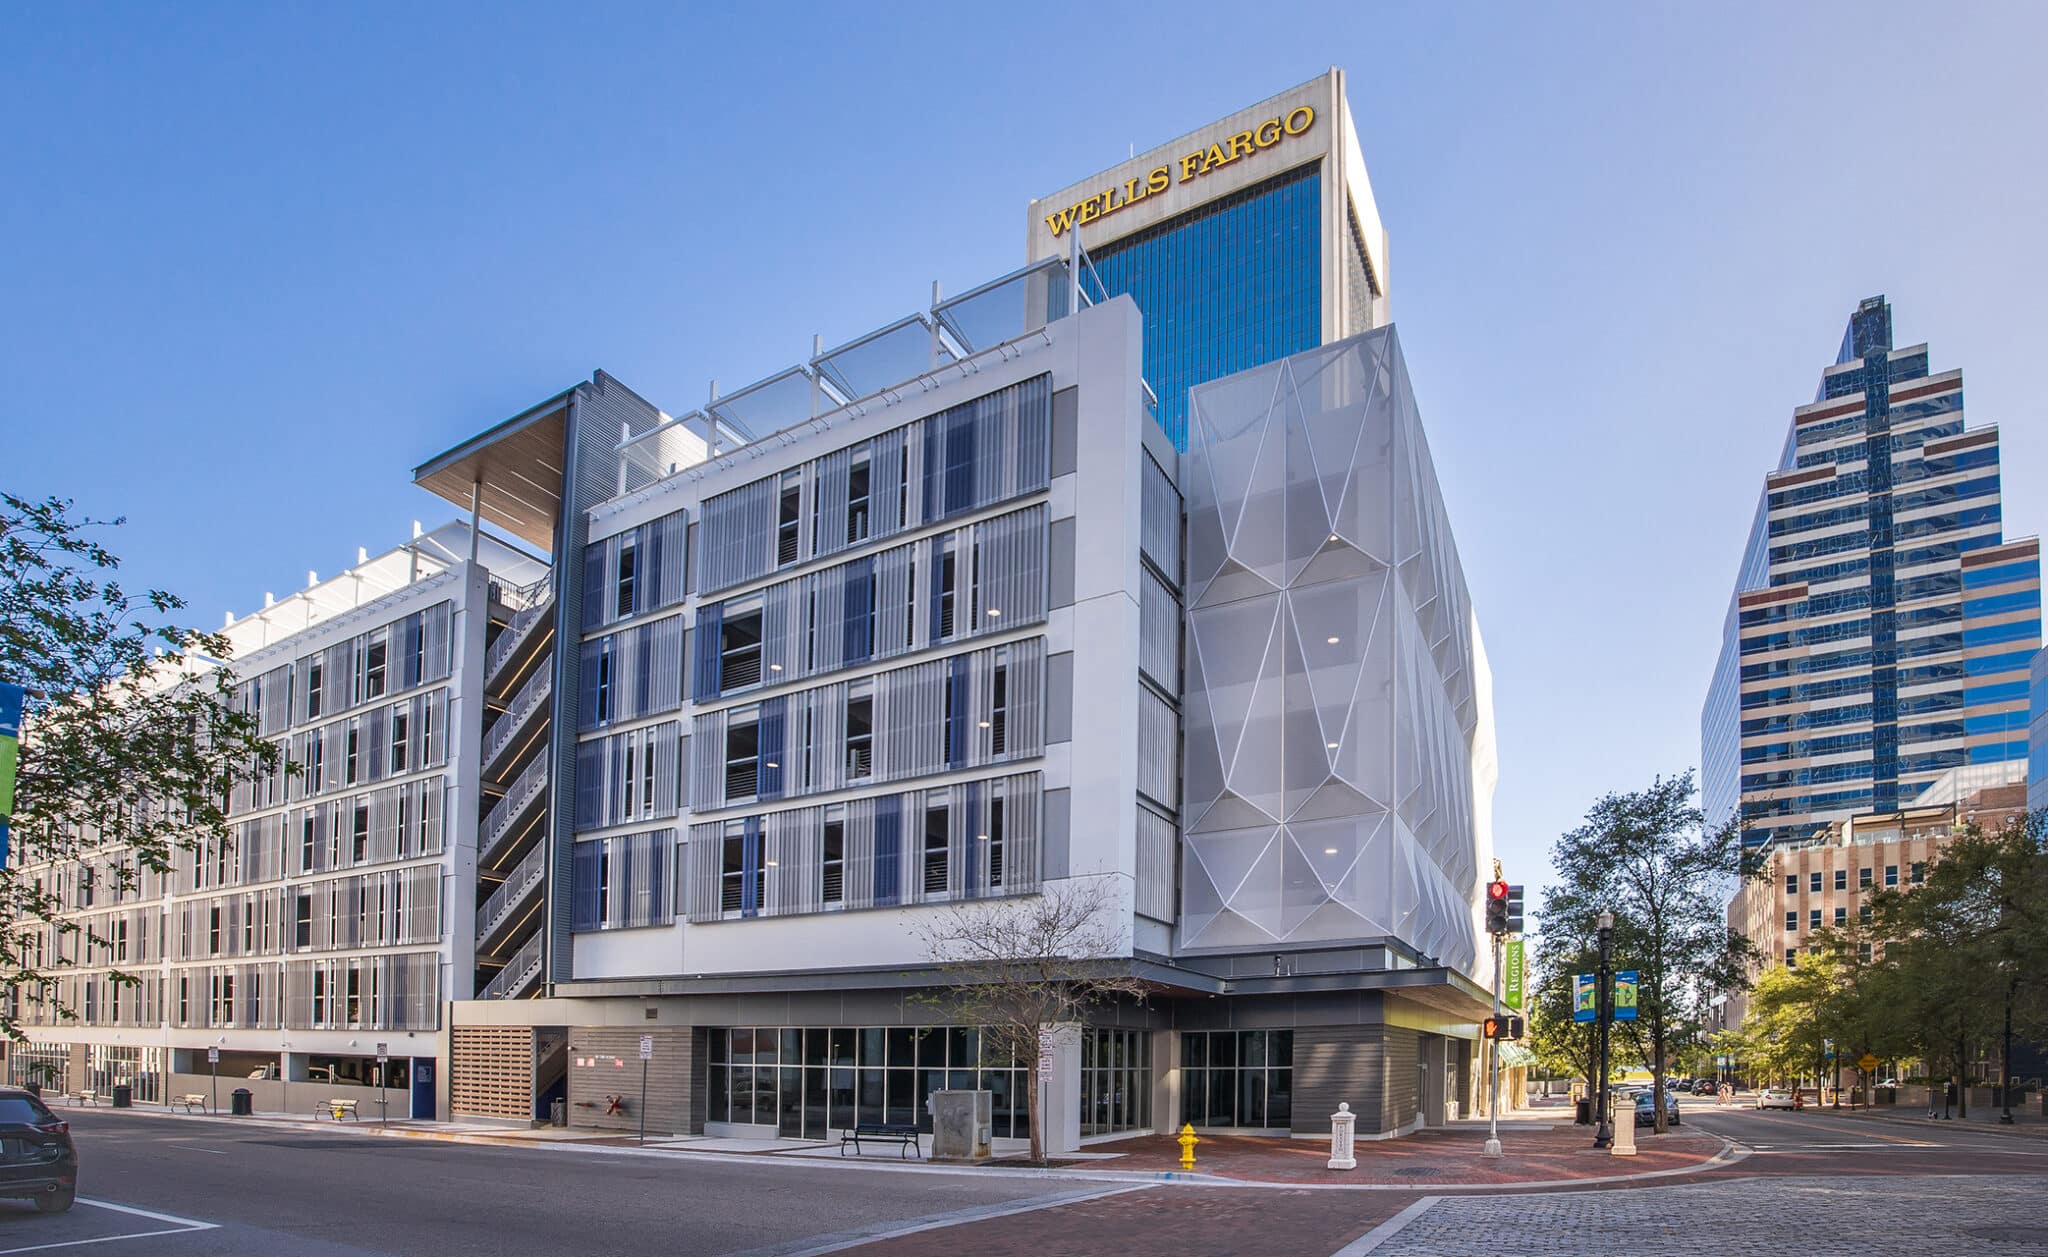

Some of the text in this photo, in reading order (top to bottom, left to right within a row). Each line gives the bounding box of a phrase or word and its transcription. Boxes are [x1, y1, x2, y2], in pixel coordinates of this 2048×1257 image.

[1045, 105, 1315, 237] WELLS FARGO
[1509, 944, 1520, 993] REGIONS
